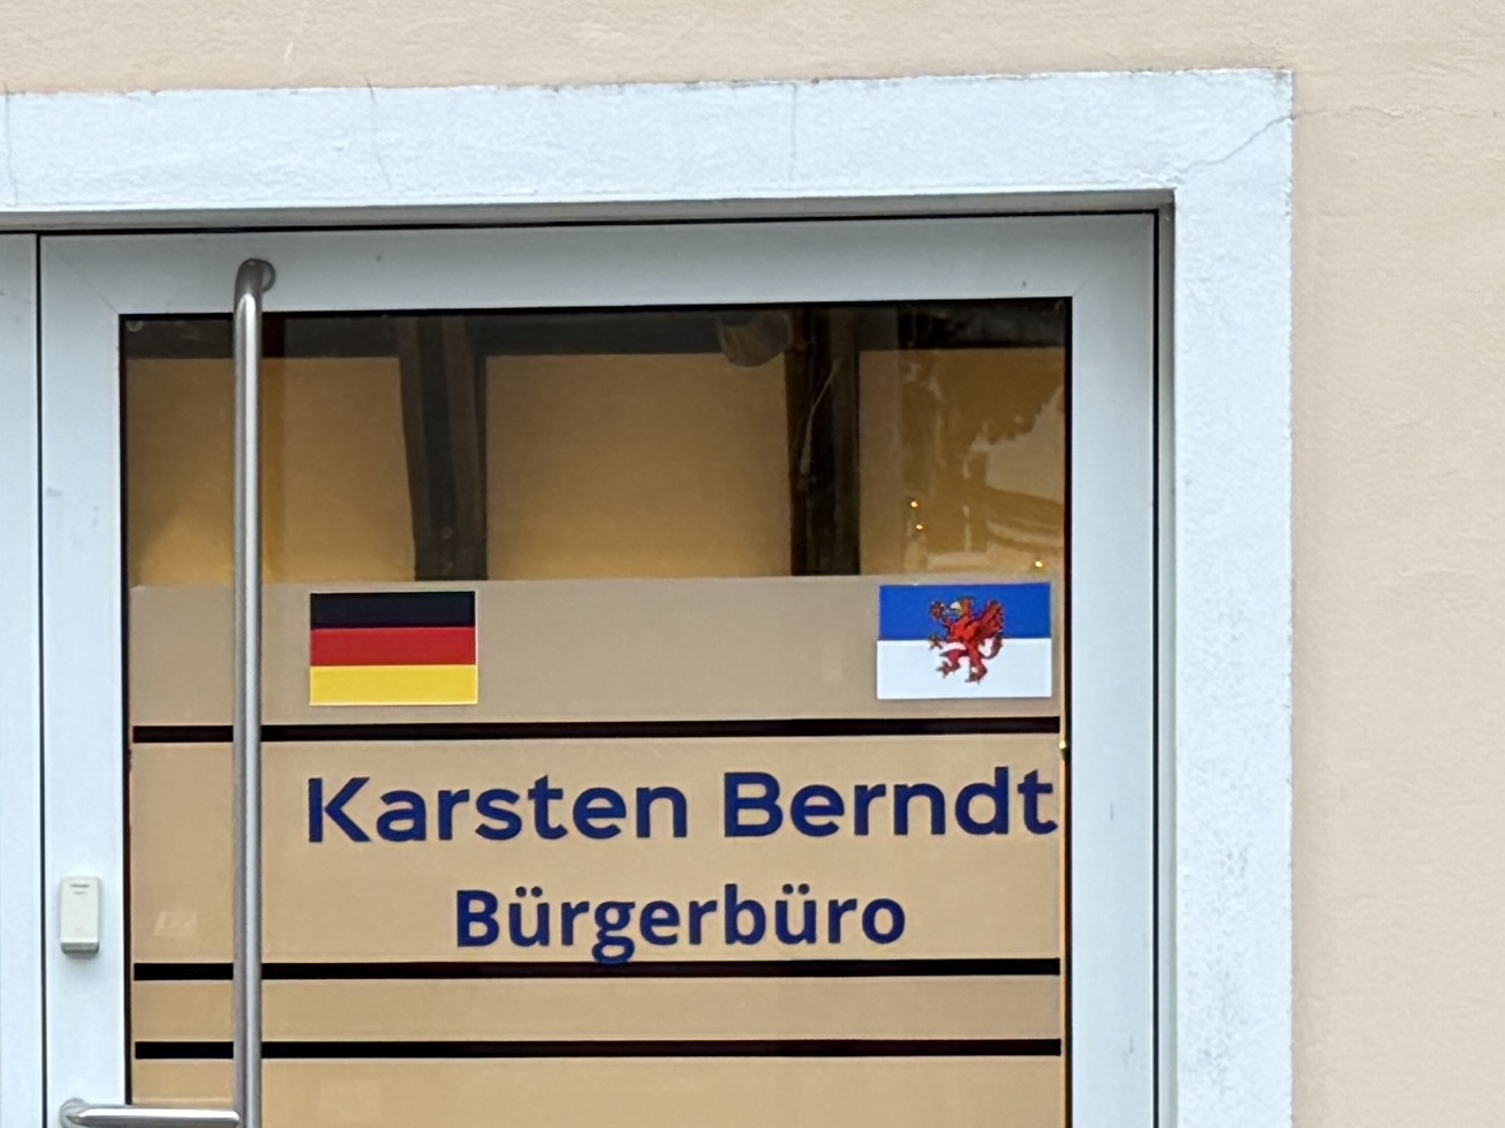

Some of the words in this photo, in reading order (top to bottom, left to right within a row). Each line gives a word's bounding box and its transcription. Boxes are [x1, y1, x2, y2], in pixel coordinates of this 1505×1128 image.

[309, 776, 687, 843] Karsten
[725, 767, 1058, 838] Berndt
[457, 884, 906, 966] Bürgerbüro
